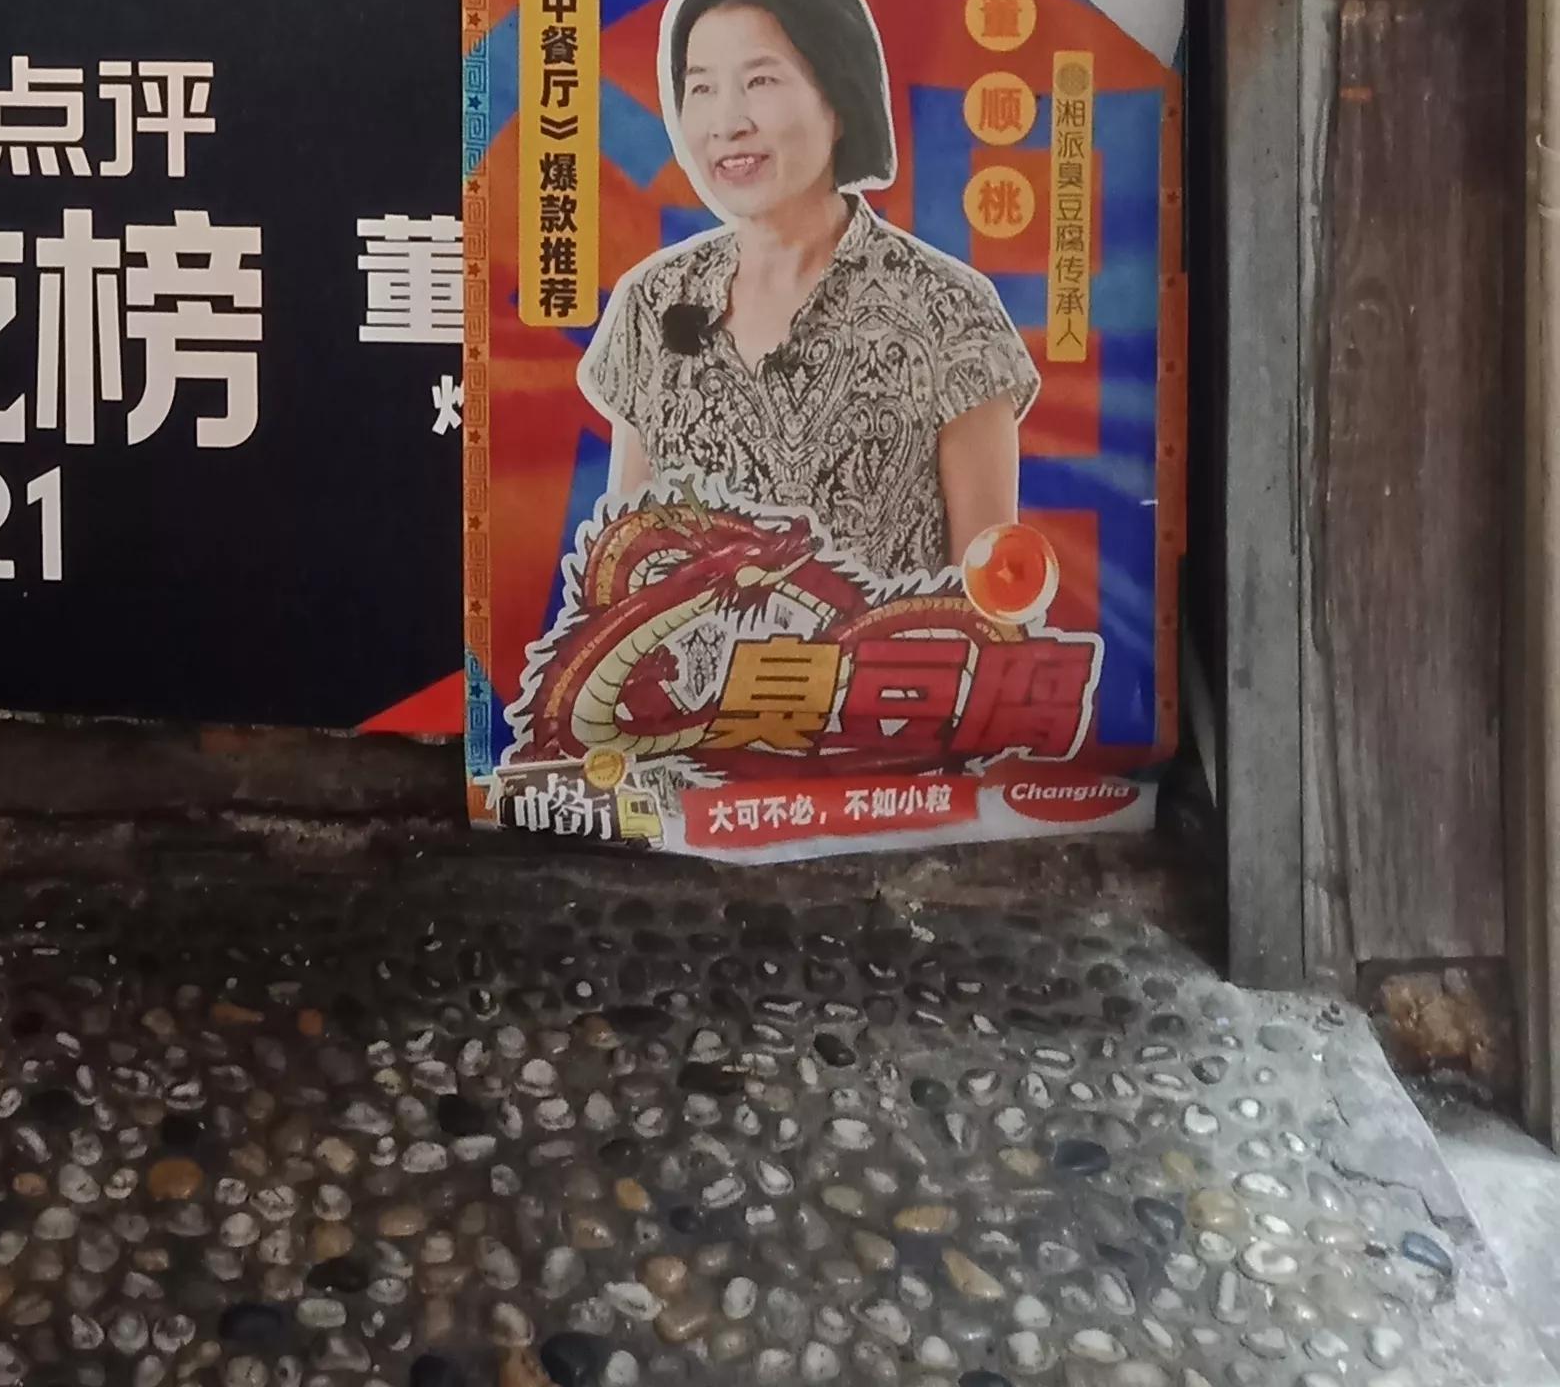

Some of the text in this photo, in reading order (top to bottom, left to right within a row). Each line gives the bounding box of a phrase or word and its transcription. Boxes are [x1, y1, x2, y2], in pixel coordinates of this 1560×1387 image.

[1054, 97, 1091, 348] 湘派臭豆腐传承人
[698, 634, 1096, 756] 臭豆腐
[1010, 780, 1132, 802] Changsha
